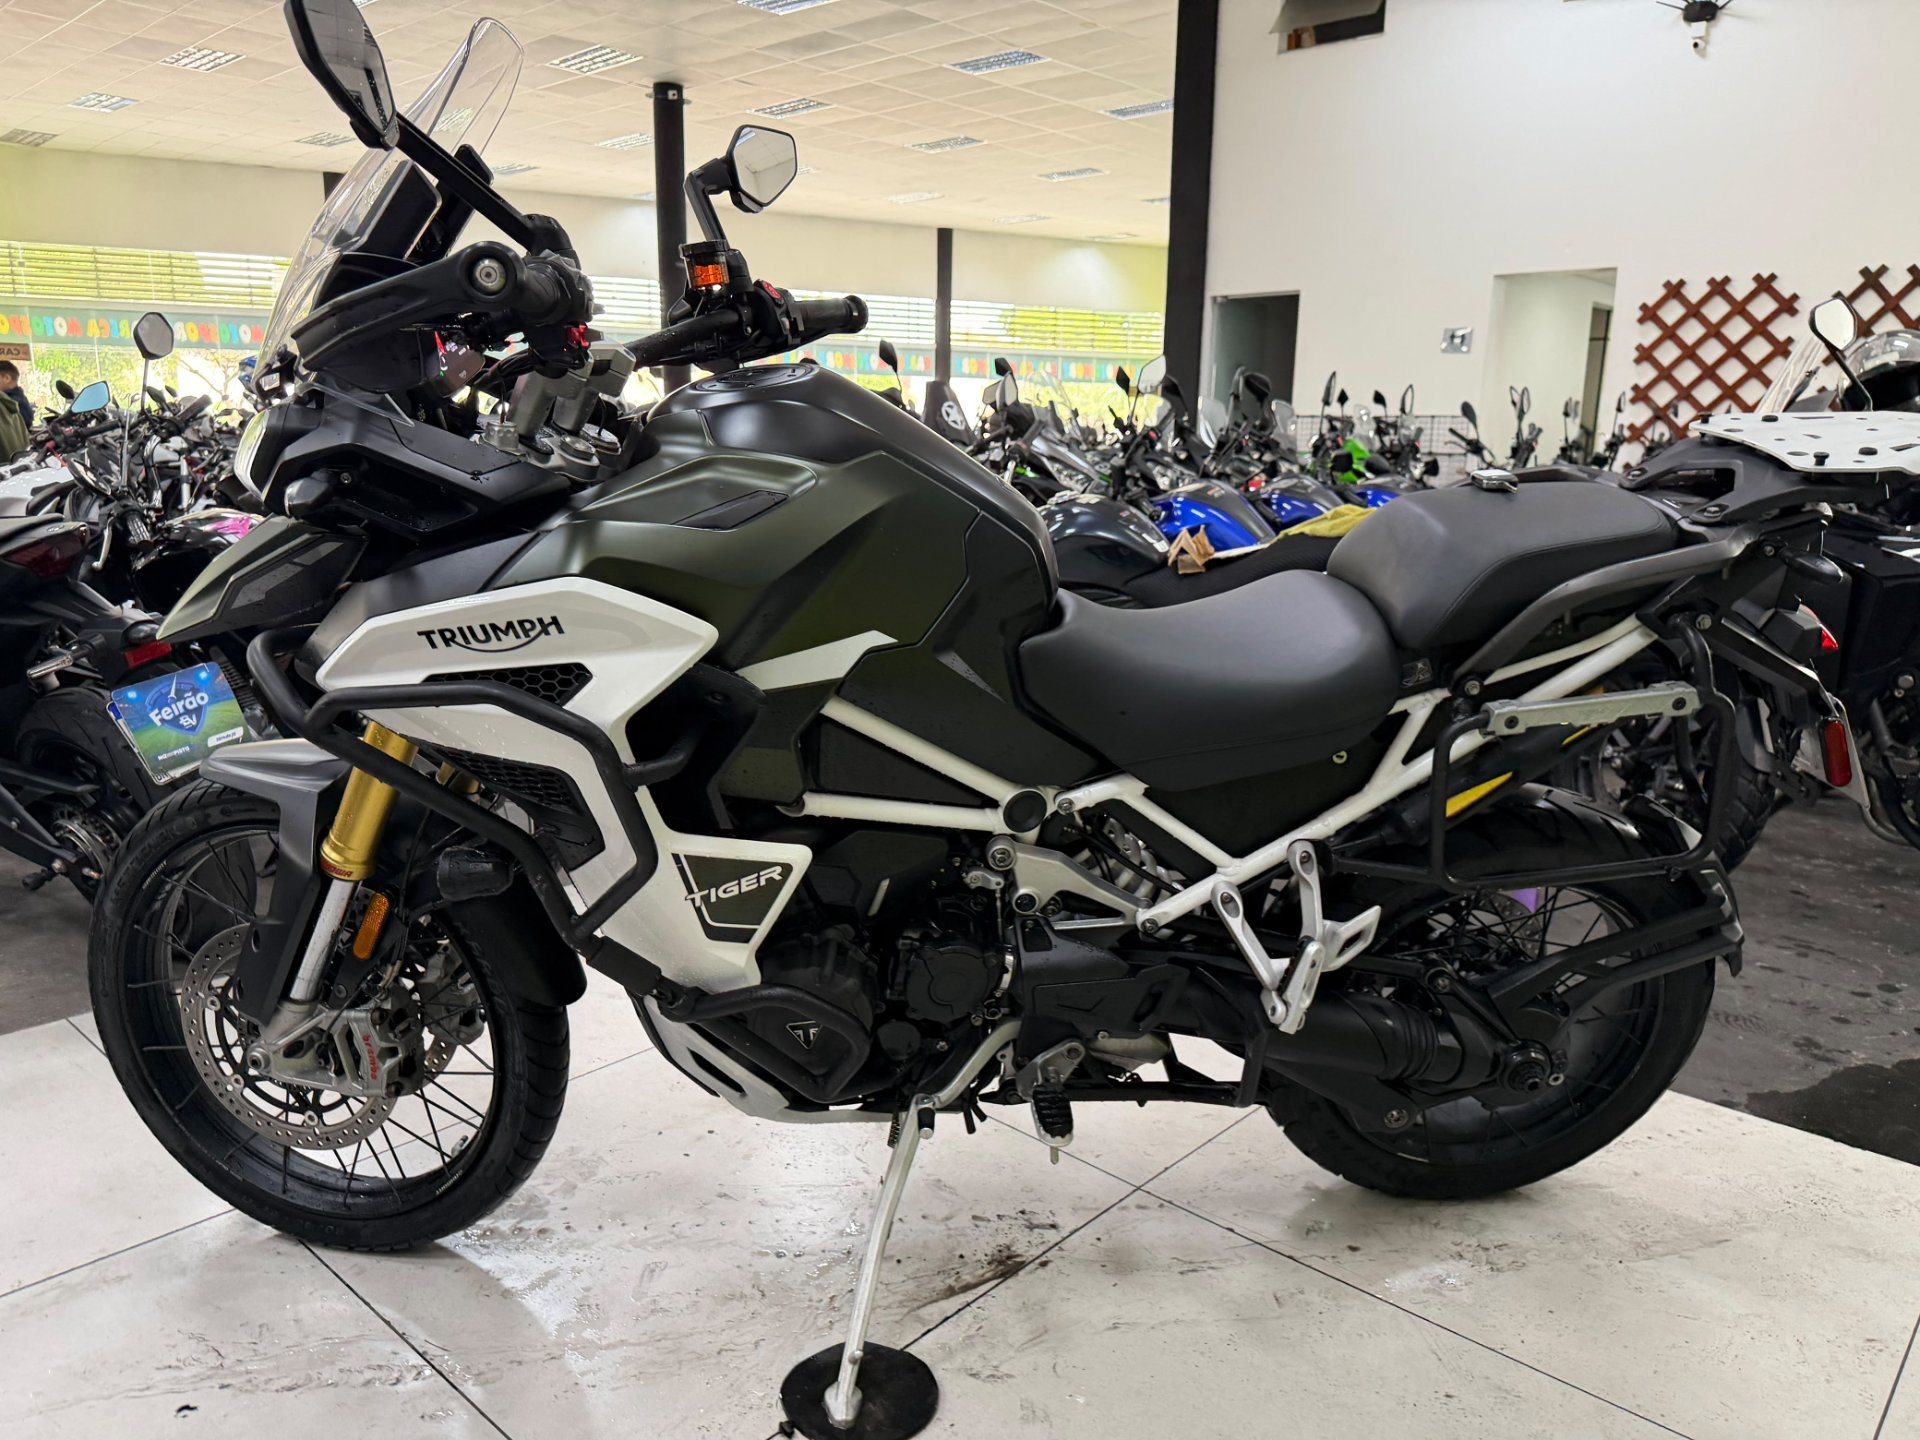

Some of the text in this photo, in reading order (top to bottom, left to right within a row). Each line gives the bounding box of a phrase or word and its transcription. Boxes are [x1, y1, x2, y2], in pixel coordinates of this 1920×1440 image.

[417, 615, 565, 653] TRIUMPH
[148, 691, 209, 727] Feirão
[684, 865, 783, 908] TIGER
[362, 1033, 378, 1080] brembo
